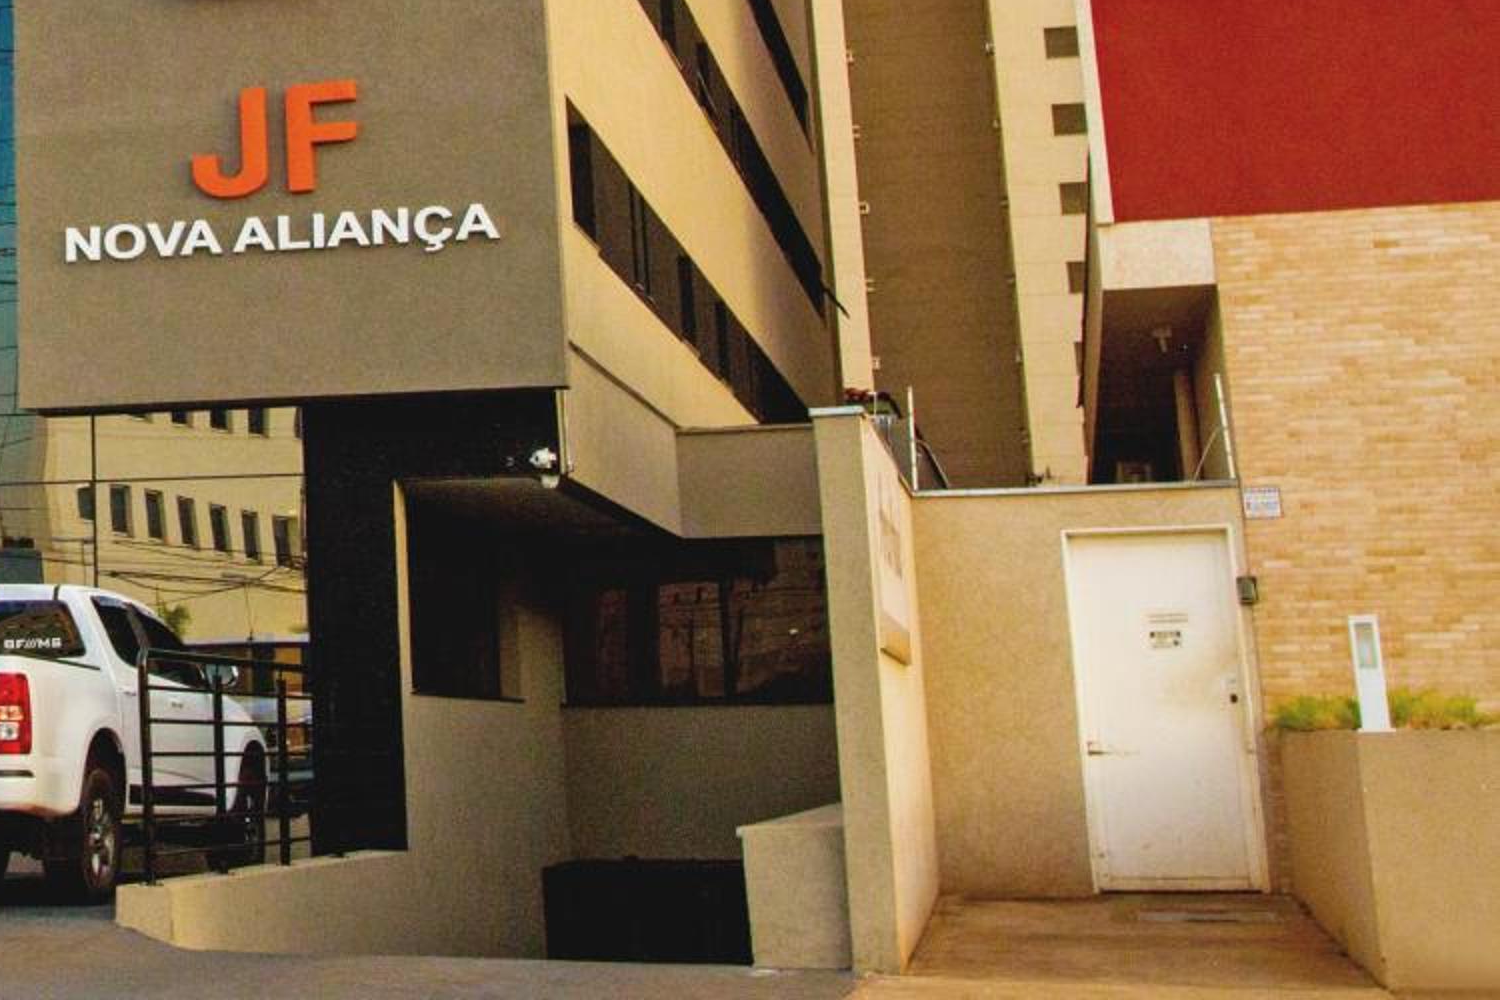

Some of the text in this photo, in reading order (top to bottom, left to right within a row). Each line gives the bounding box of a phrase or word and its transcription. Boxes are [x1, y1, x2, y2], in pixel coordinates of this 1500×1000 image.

[192, 80, 358, 198] JF
[65, 203, 500, 262] NOVA ALIANÇA
